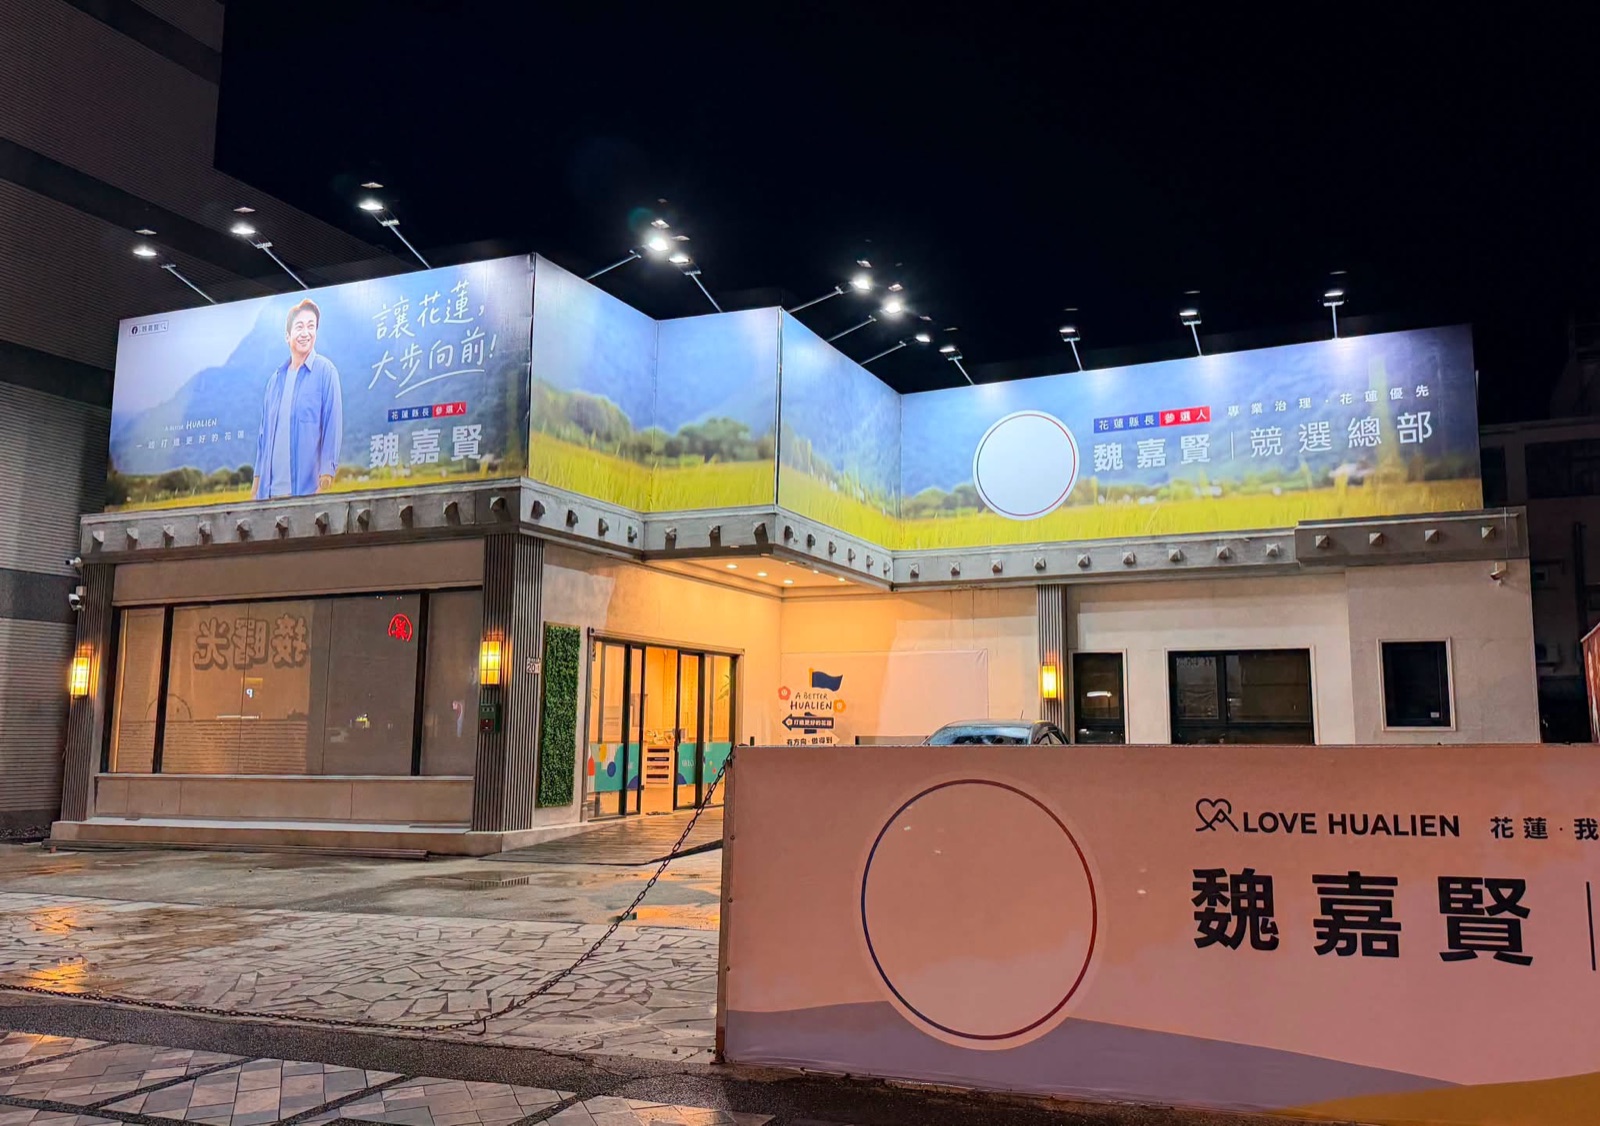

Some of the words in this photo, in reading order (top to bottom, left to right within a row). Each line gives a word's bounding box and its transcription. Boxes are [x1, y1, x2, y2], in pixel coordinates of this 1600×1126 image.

[186, 418, 218, 430] HUALIEN
[369, 424, 483, 469] 魏嘉賢
[1093, 433, 1211, 473] 魏嘉賢
[1250, 411, 1432, 458] 競選總部
[790, 700, 832, 710] HUALIEN
[795, 692, 801, 700] A
[803, 691, 828, 700] BETTER
[1243, 811, 1317, 834] LOVE
[1328, 814, 1459, 837] HUALIEN
[1191, 867, 1533, 966] 魏嘉賢
